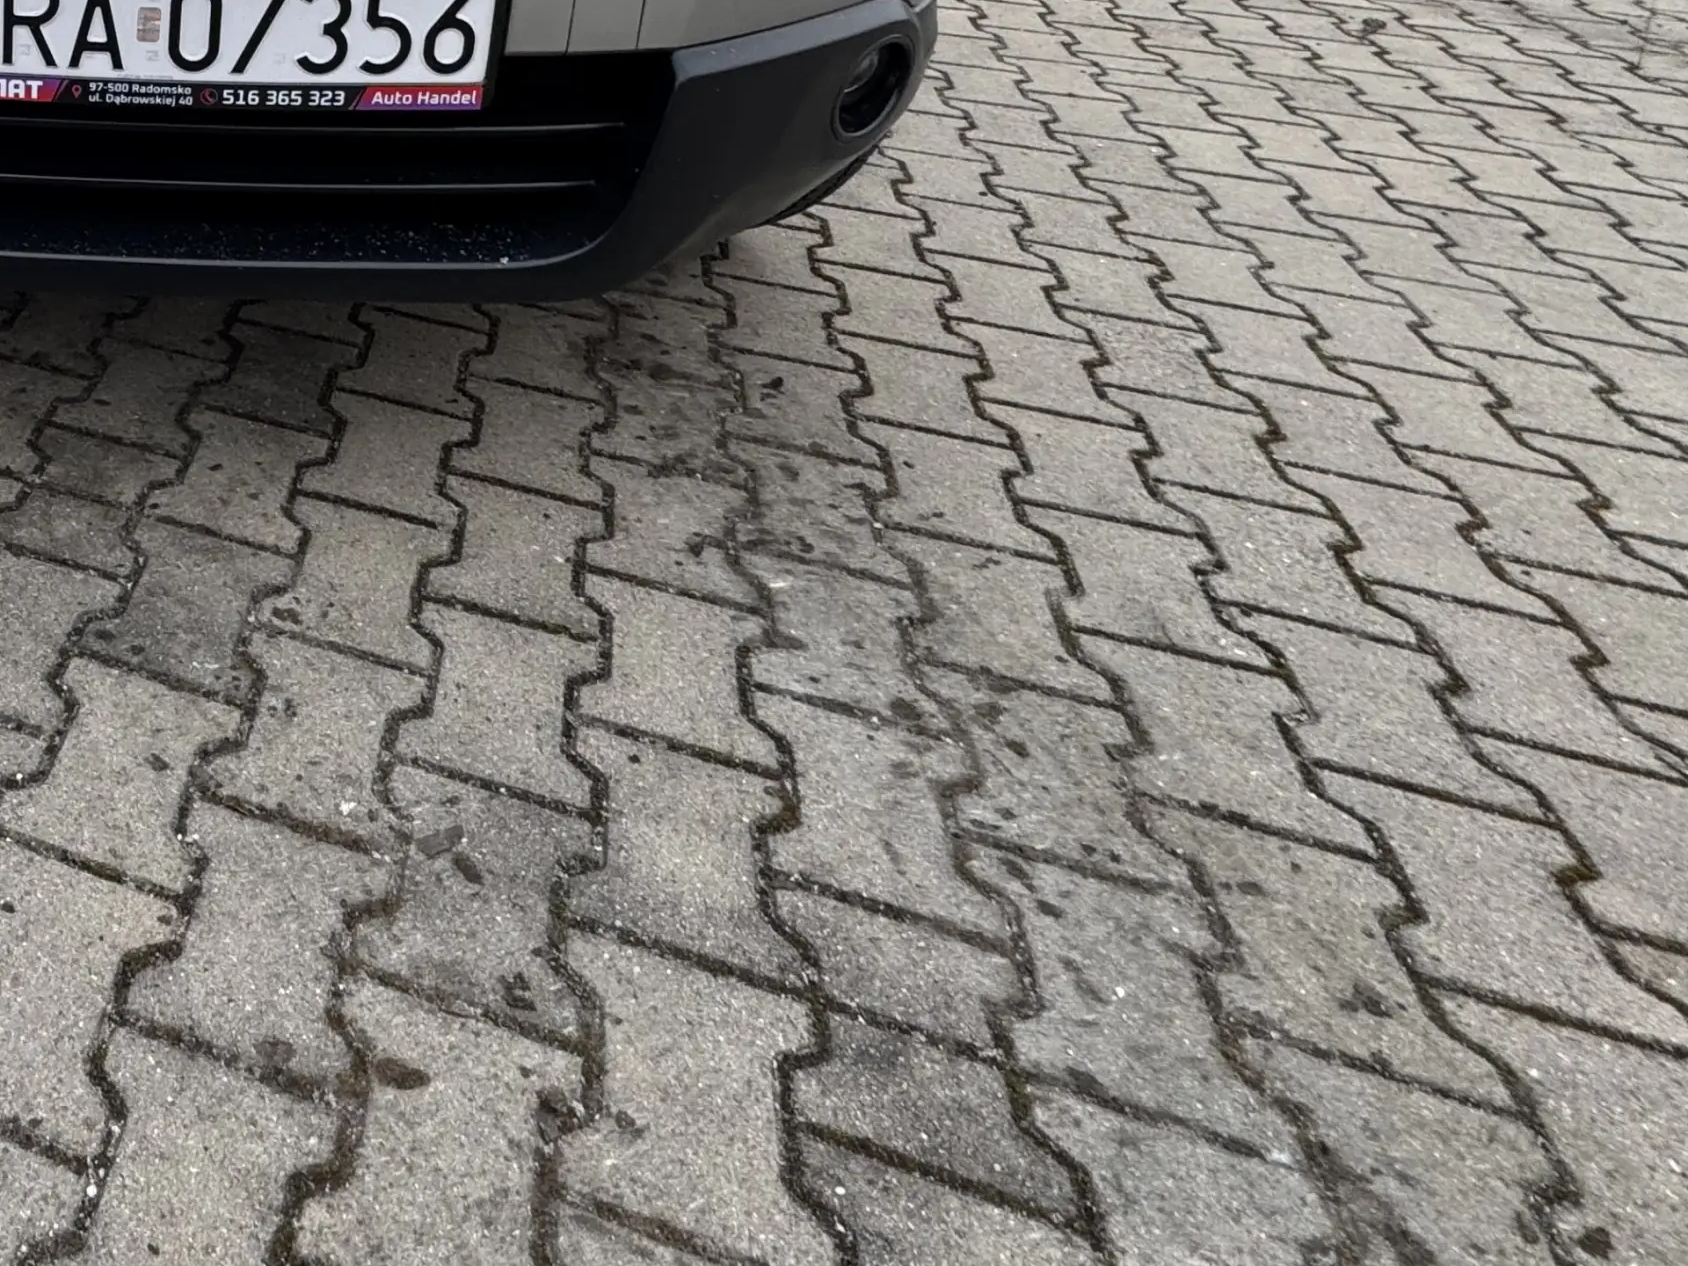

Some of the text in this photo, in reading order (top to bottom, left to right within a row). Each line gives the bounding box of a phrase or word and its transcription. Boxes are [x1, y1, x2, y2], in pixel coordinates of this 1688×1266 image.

[89, 82, 191, 94] 97-500 Radomsko
[89, 93, 193, 106] ul. Dąbrowskiej 40
[222, 90, 346, 106] 516 365 323
[371, 90, 477, 105] Auto Handel
